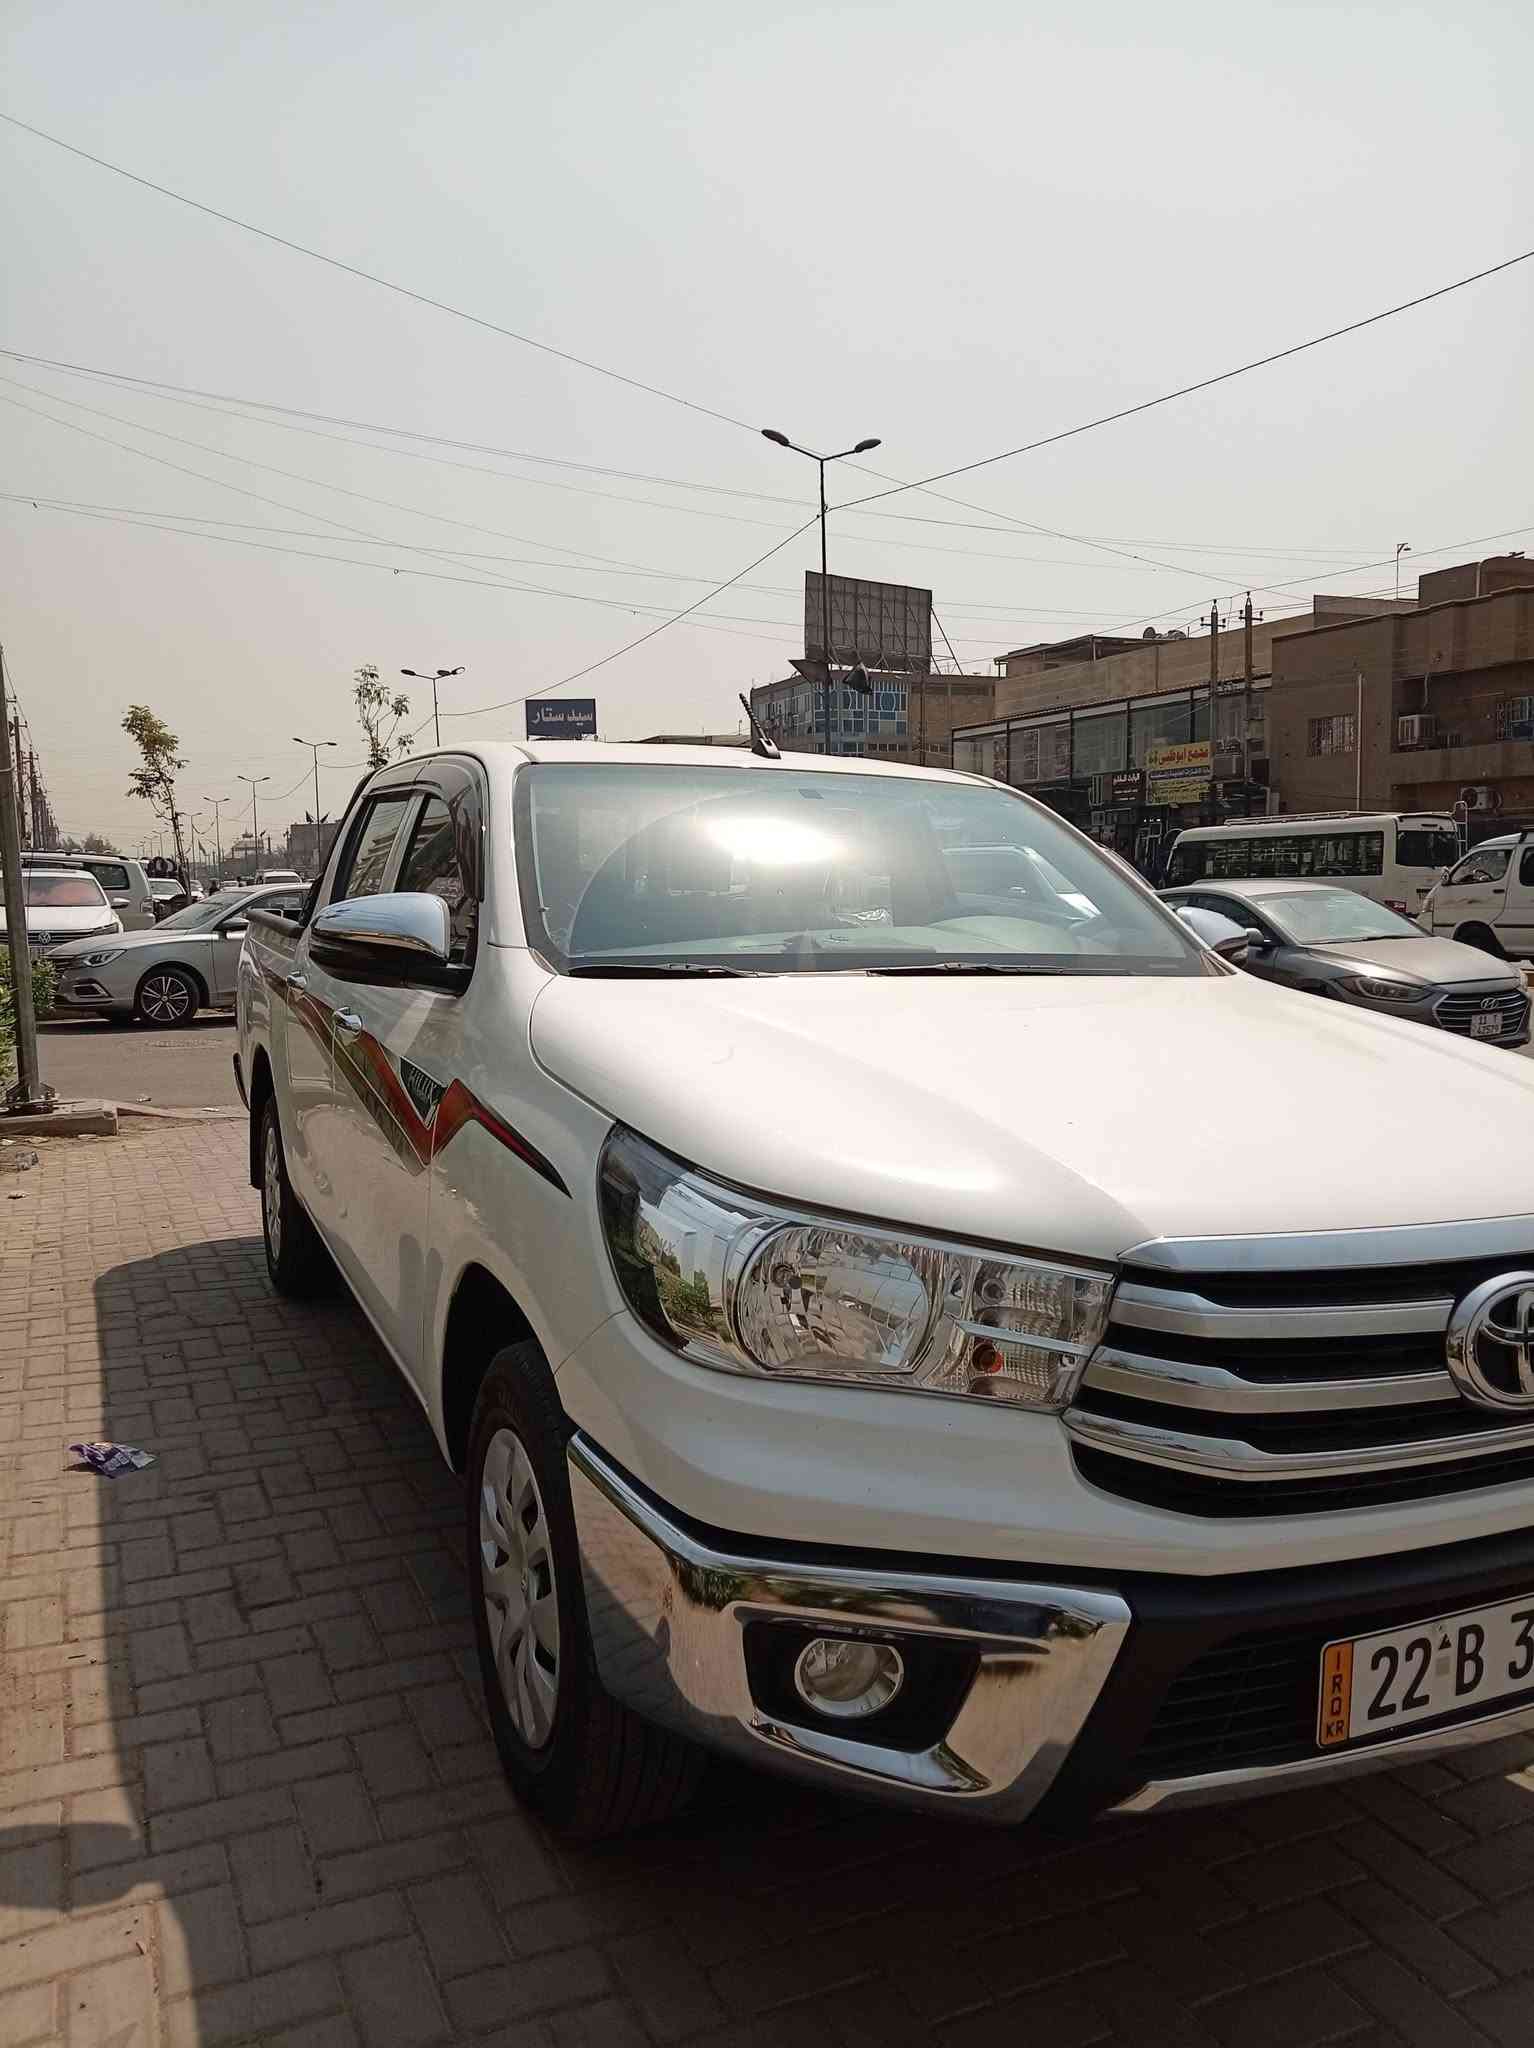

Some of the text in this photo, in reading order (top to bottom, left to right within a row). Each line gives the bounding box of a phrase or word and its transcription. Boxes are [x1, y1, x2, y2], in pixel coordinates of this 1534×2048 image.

[531, 707, 565, 724] ستار
[1367, 1636, 1433, 1721] 22
[1455, 1623, 1485, 1697] B
